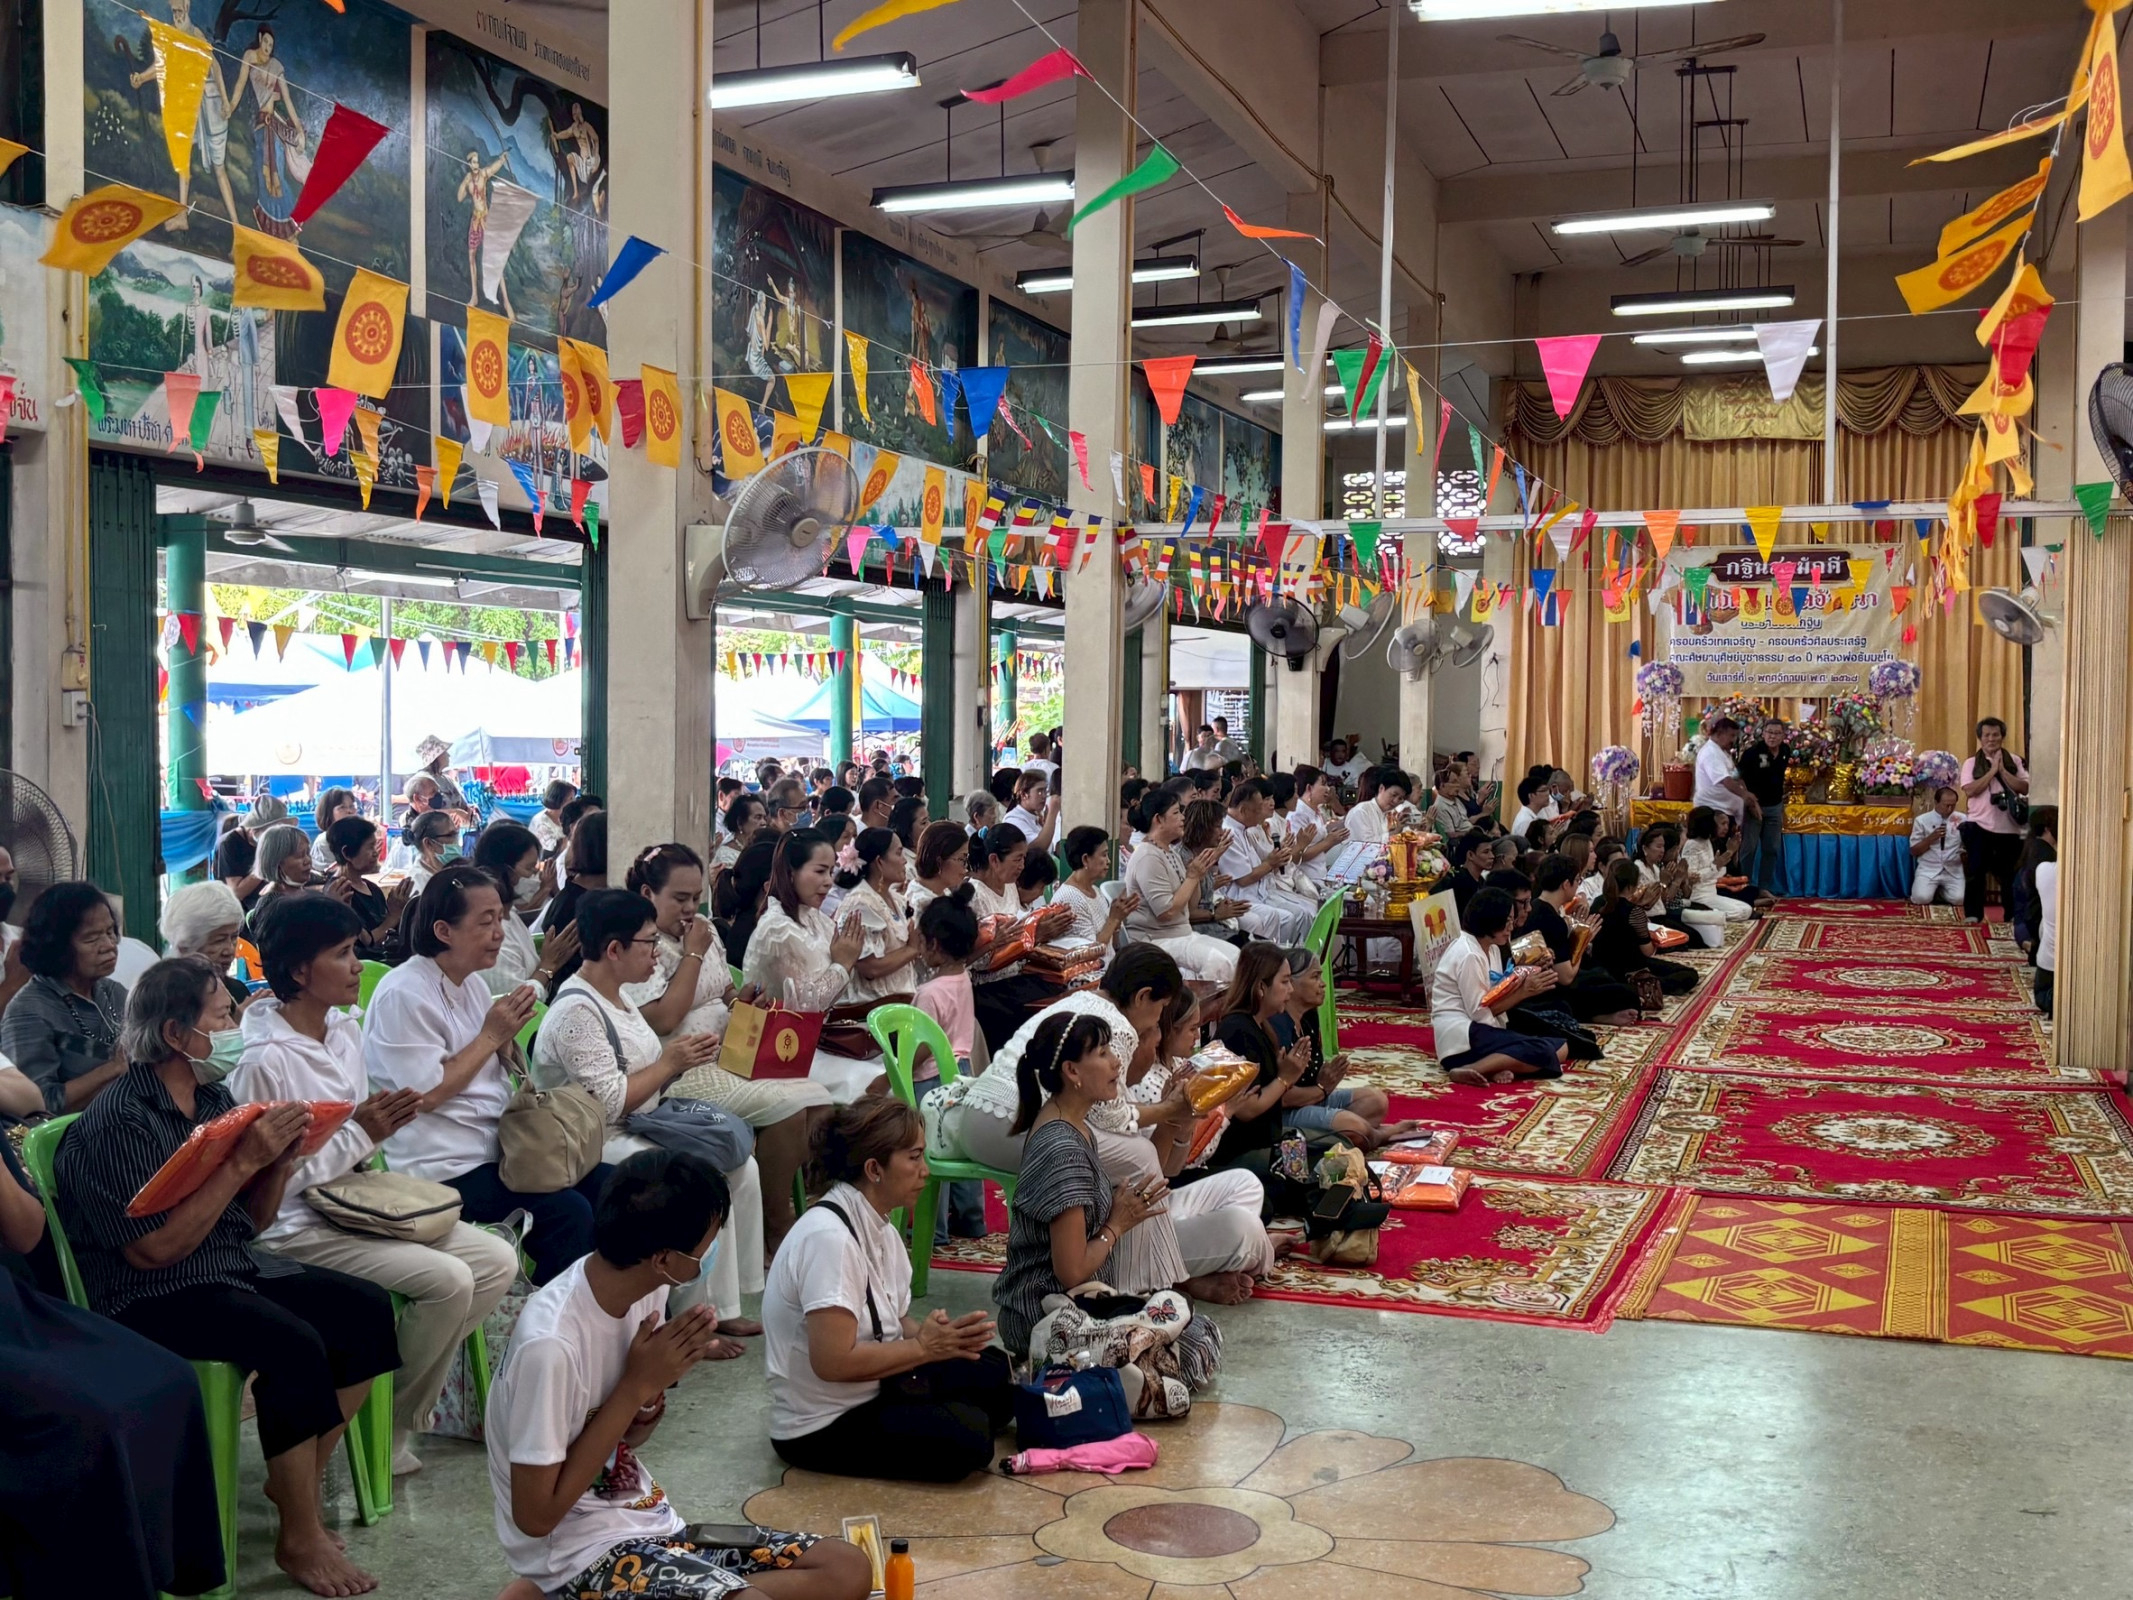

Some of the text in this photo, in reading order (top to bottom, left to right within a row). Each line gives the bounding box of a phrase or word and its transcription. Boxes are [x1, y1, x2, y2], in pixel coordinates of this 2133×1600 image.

[1726, 555, 1841, 578] กฐินมัคคี
[1806, 651, 1812, 662] ปี
[1758, 672, 1807, 684] พฤศจิกายน
